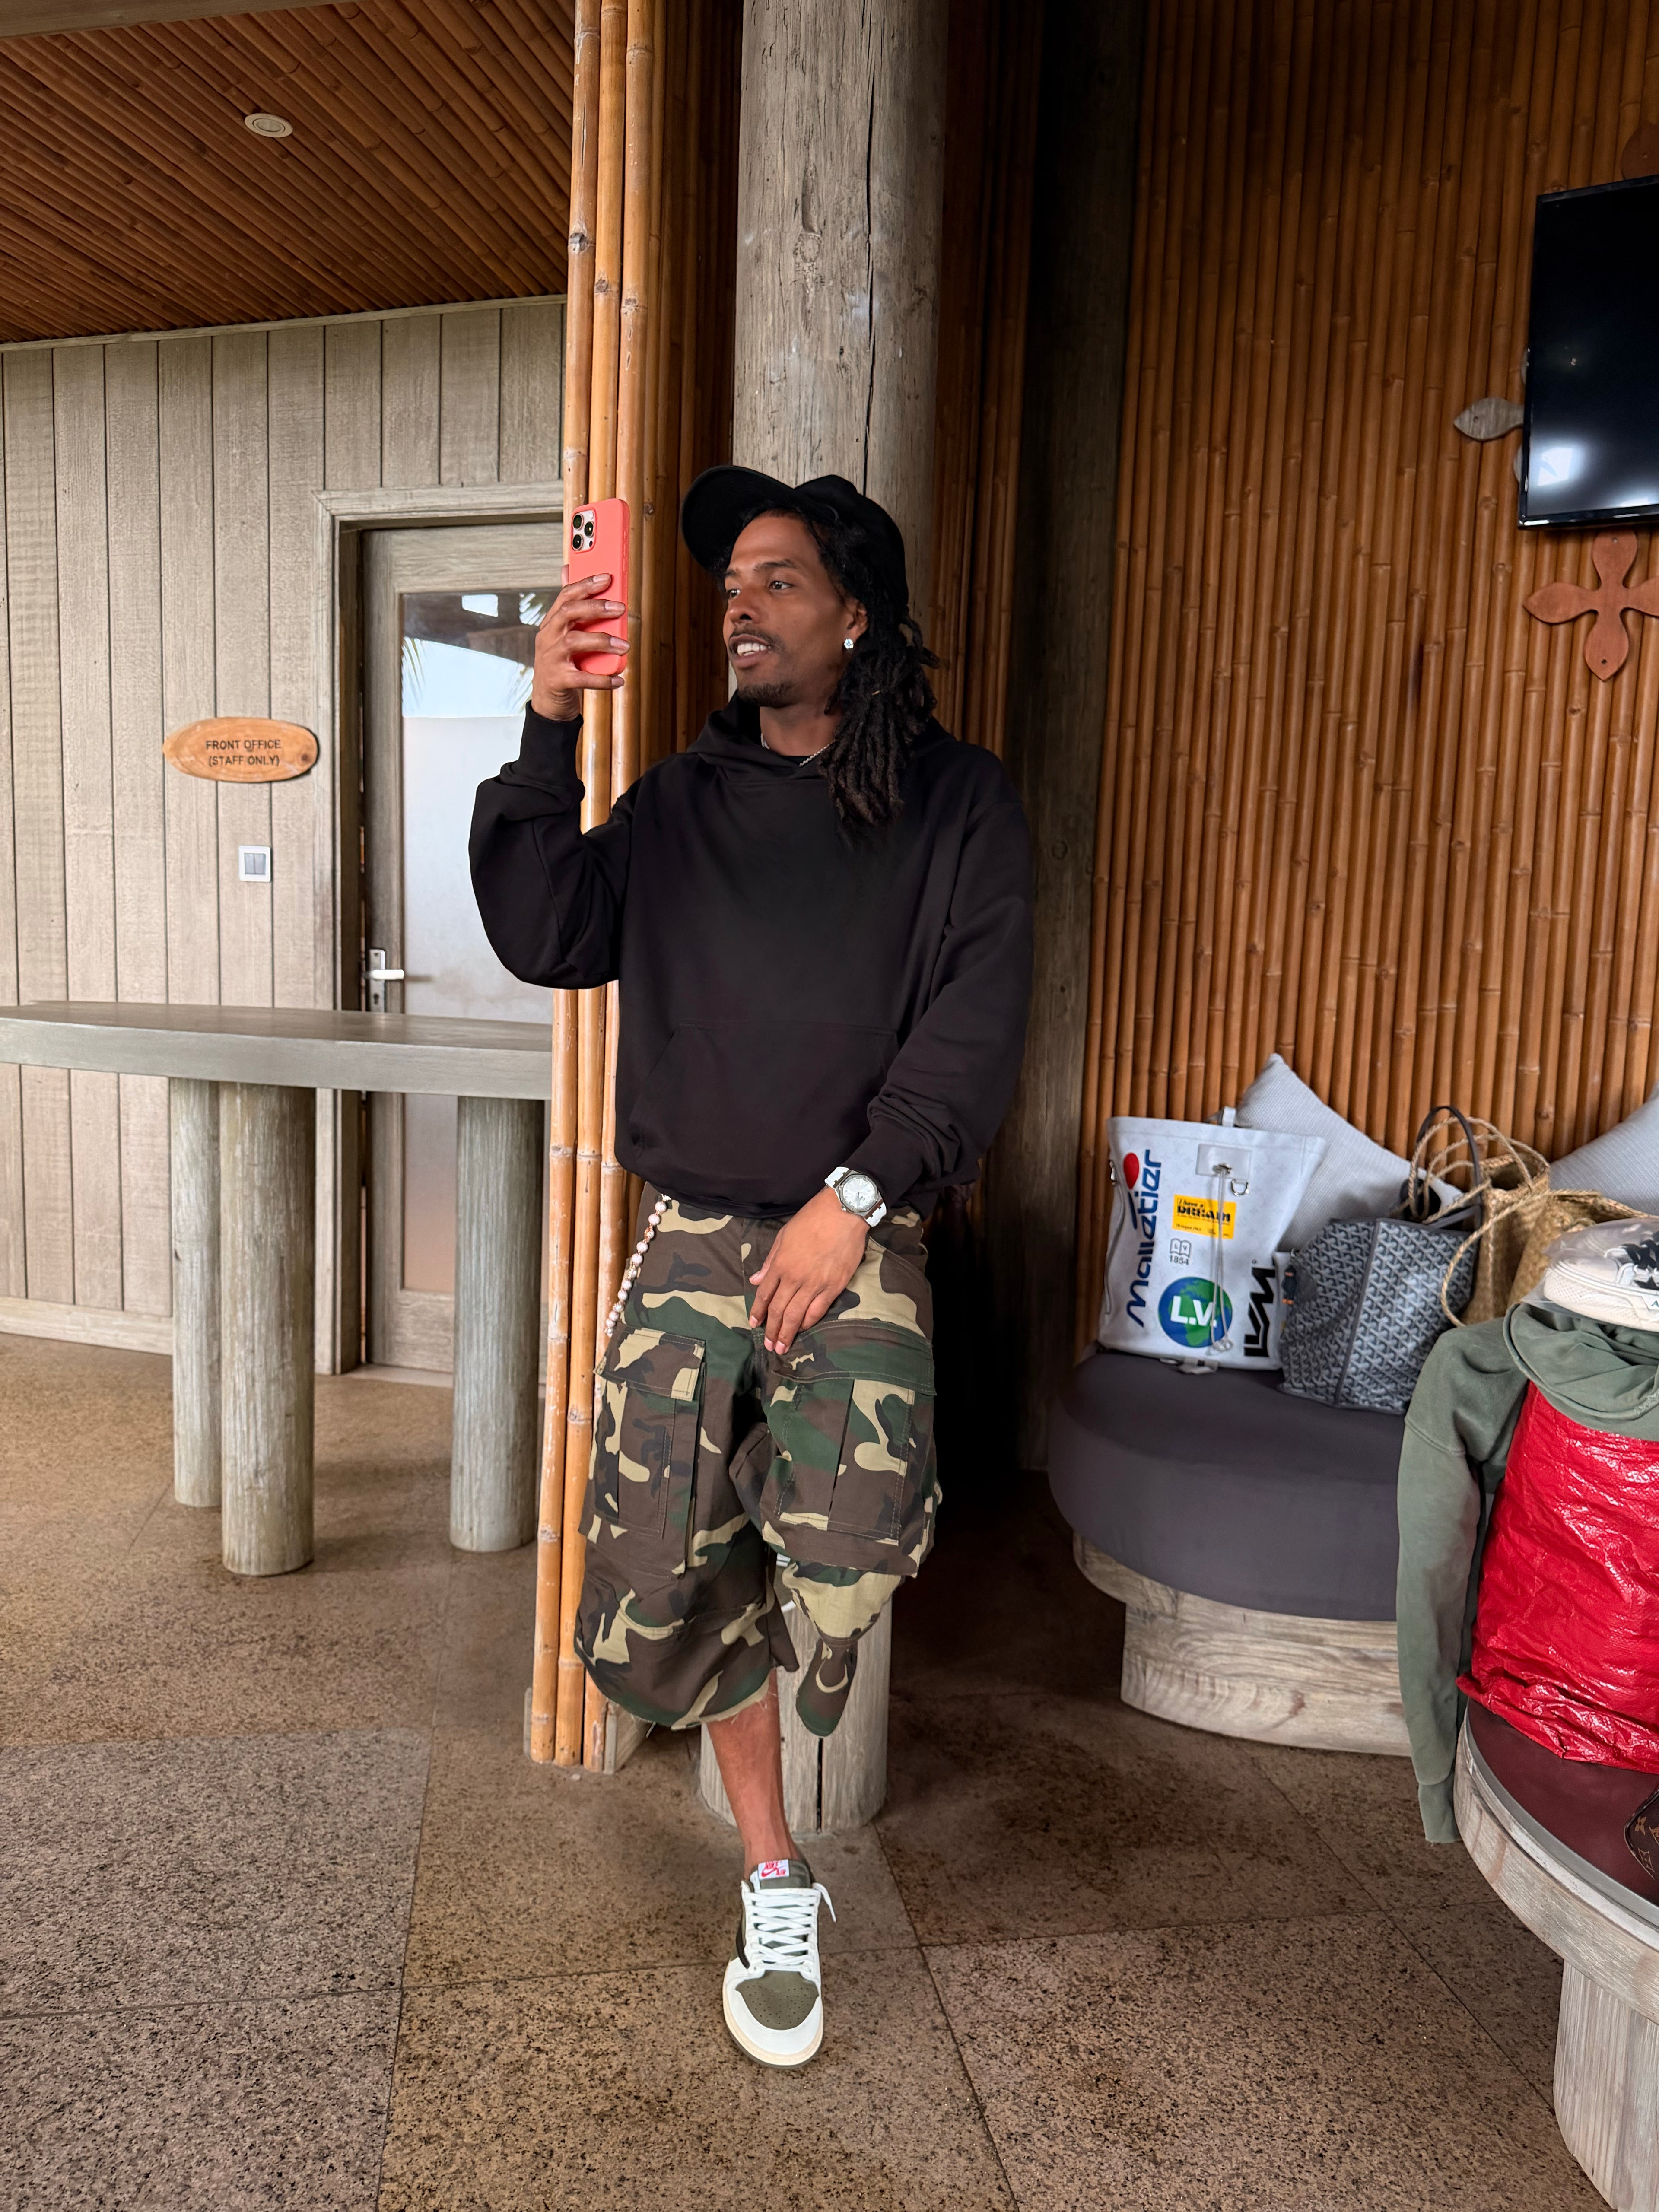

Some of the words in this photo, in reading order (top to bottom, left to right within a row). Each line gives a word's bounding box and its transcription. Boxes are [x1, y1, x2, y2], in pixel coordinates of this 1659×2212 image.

[206, 740, 240, 750] FRONT
[244, 739, 281, 750] OFFICE
[209, 755, 244, 767] (STAFF
[248, 755, 280, 767] ONLY)
[765, 1861, 779, 1870] NIKE
